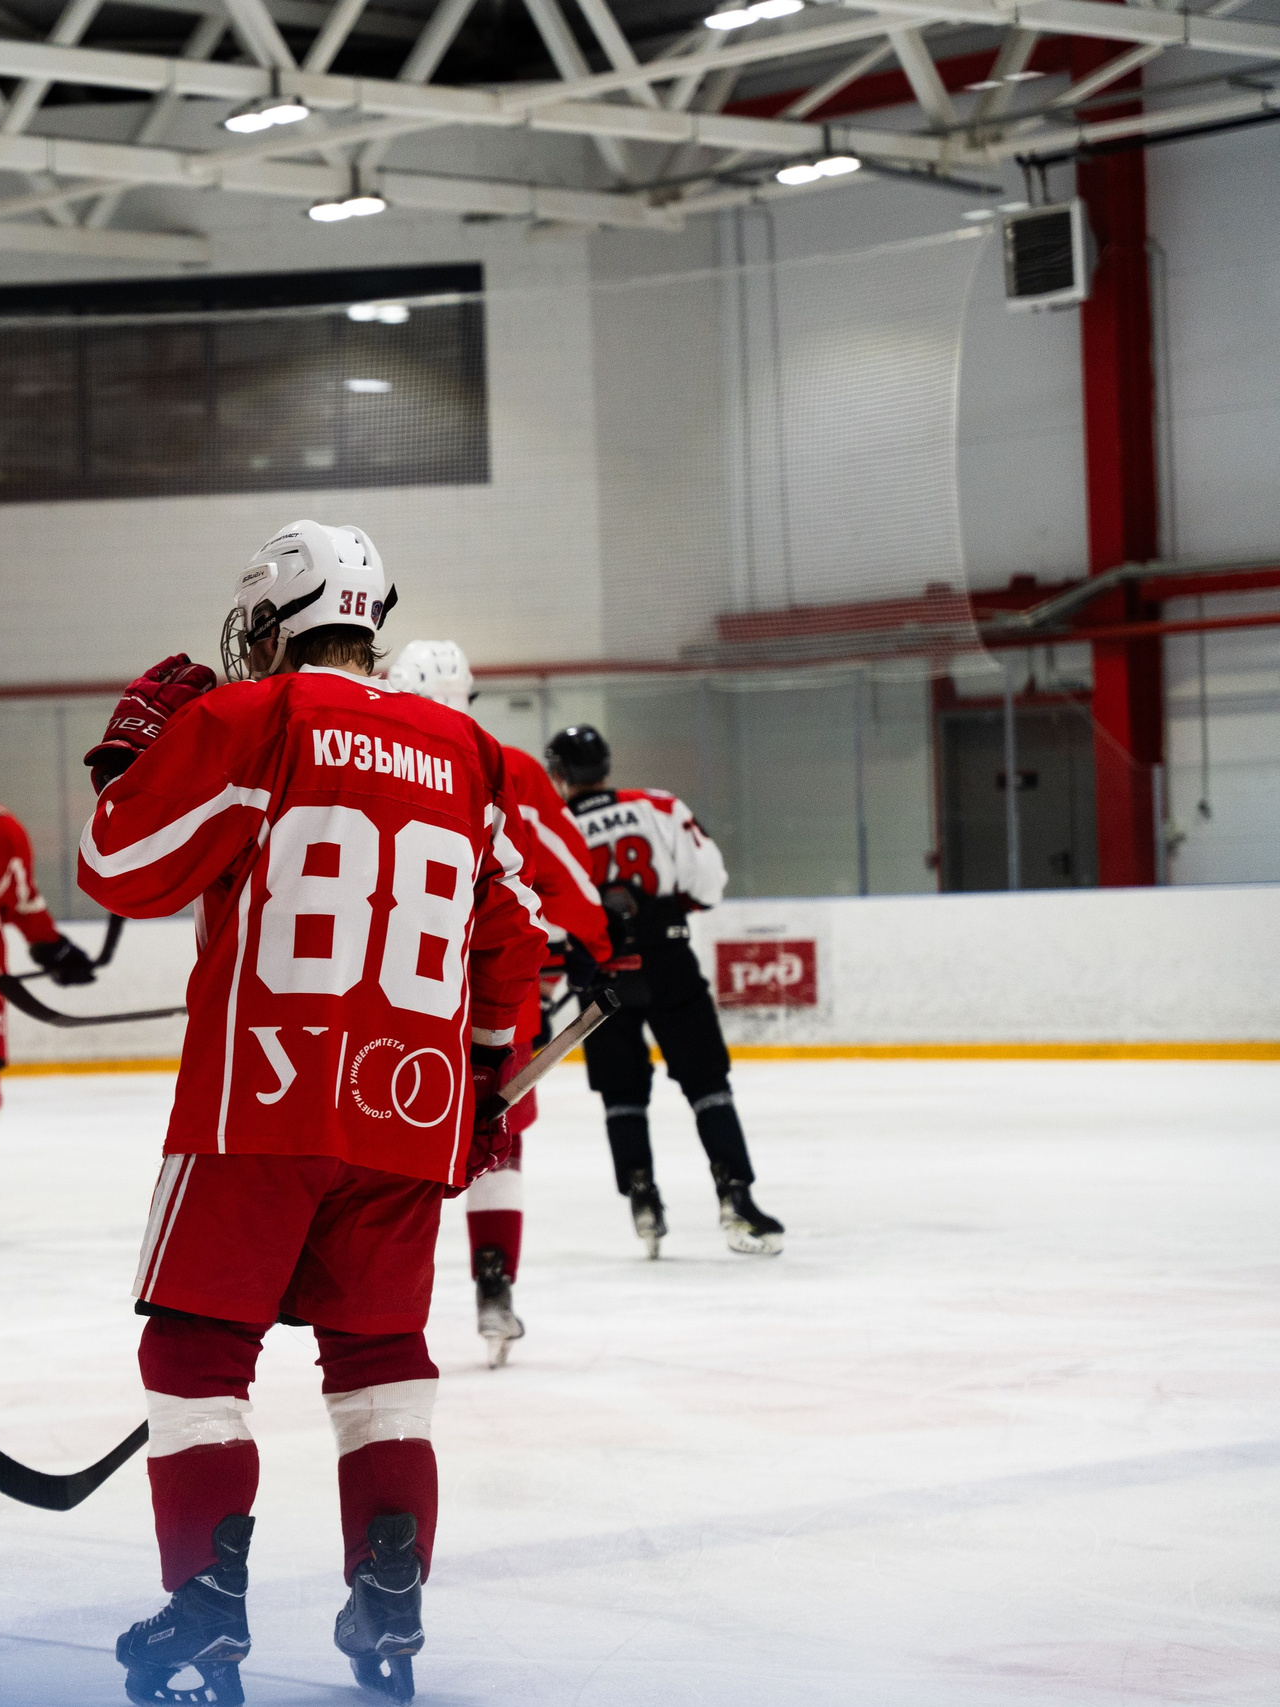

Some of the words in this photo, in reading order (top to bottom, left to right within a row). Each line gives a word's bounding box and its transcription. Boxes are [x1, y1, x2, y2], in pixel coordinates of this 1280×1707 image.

[339, 590, 367, 616] 36
[312, 729, 453, 795] КУЗЬМИН
[256, 805, 475, 1021] 88
[350, 1037, 406, 1084] УНИВЕРСИТЕТА
[352, 1089, 392, 1119] СТОЛЕТИЕ
